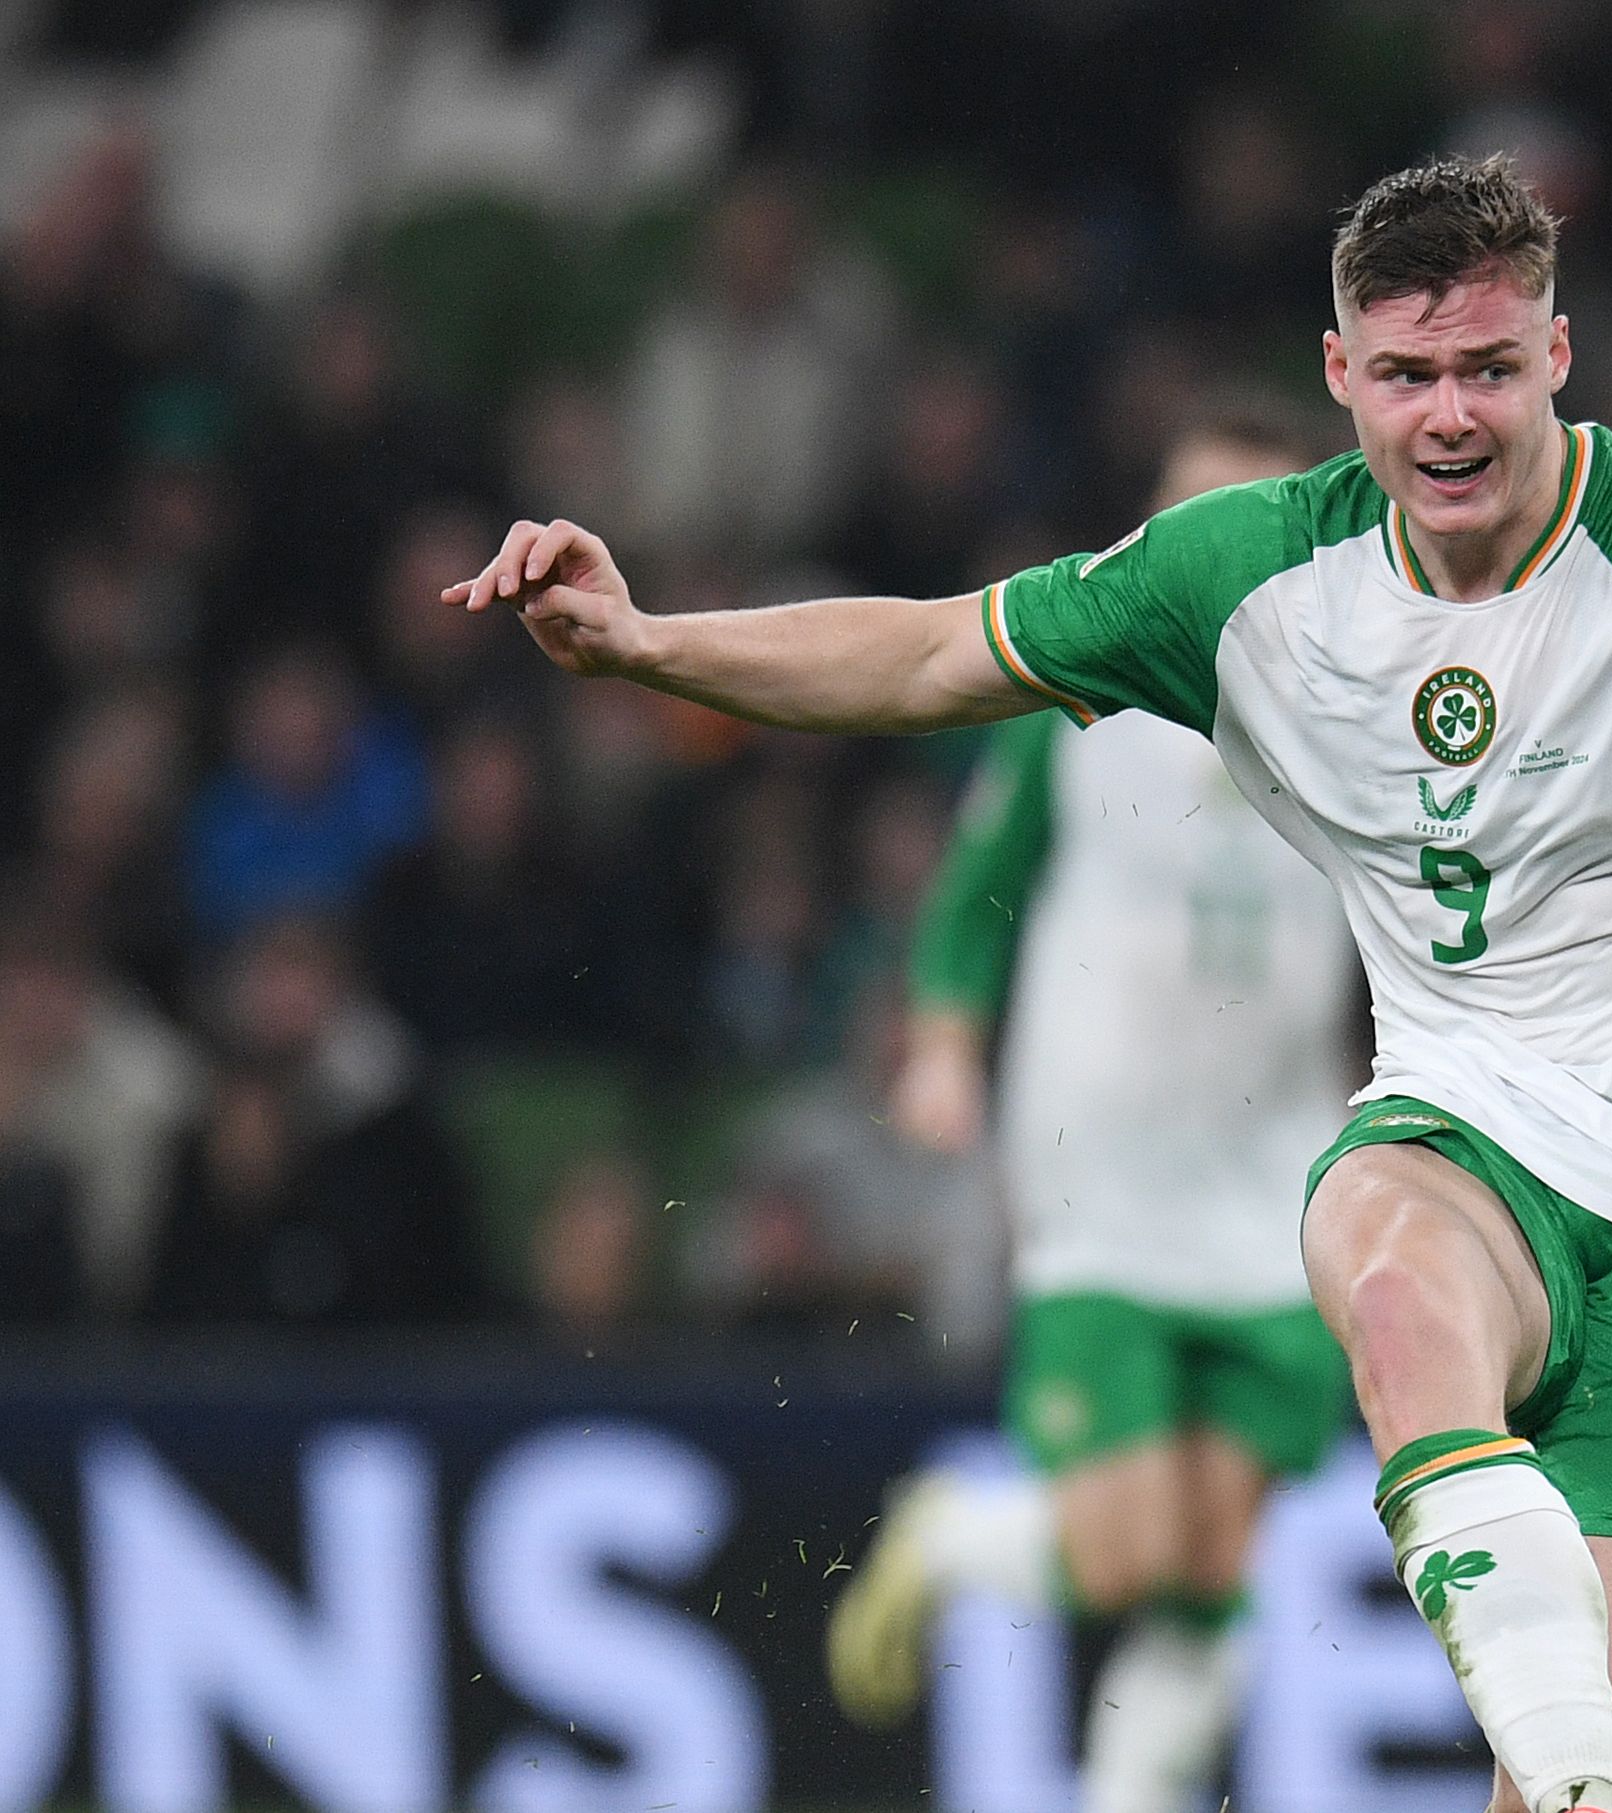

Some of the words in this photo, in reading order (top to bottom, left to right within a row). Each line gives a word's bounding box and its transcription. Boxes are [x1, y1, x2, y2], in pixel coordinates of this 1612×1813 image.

[1422, 672, 1491, 708] IRELAND
[1519, 747, 1564, 765] FINLAND
[1519, 760, 1569, 776] November
[1419, 845, 1492, 965] 9
[0, 1420, 770, 1813] NS
